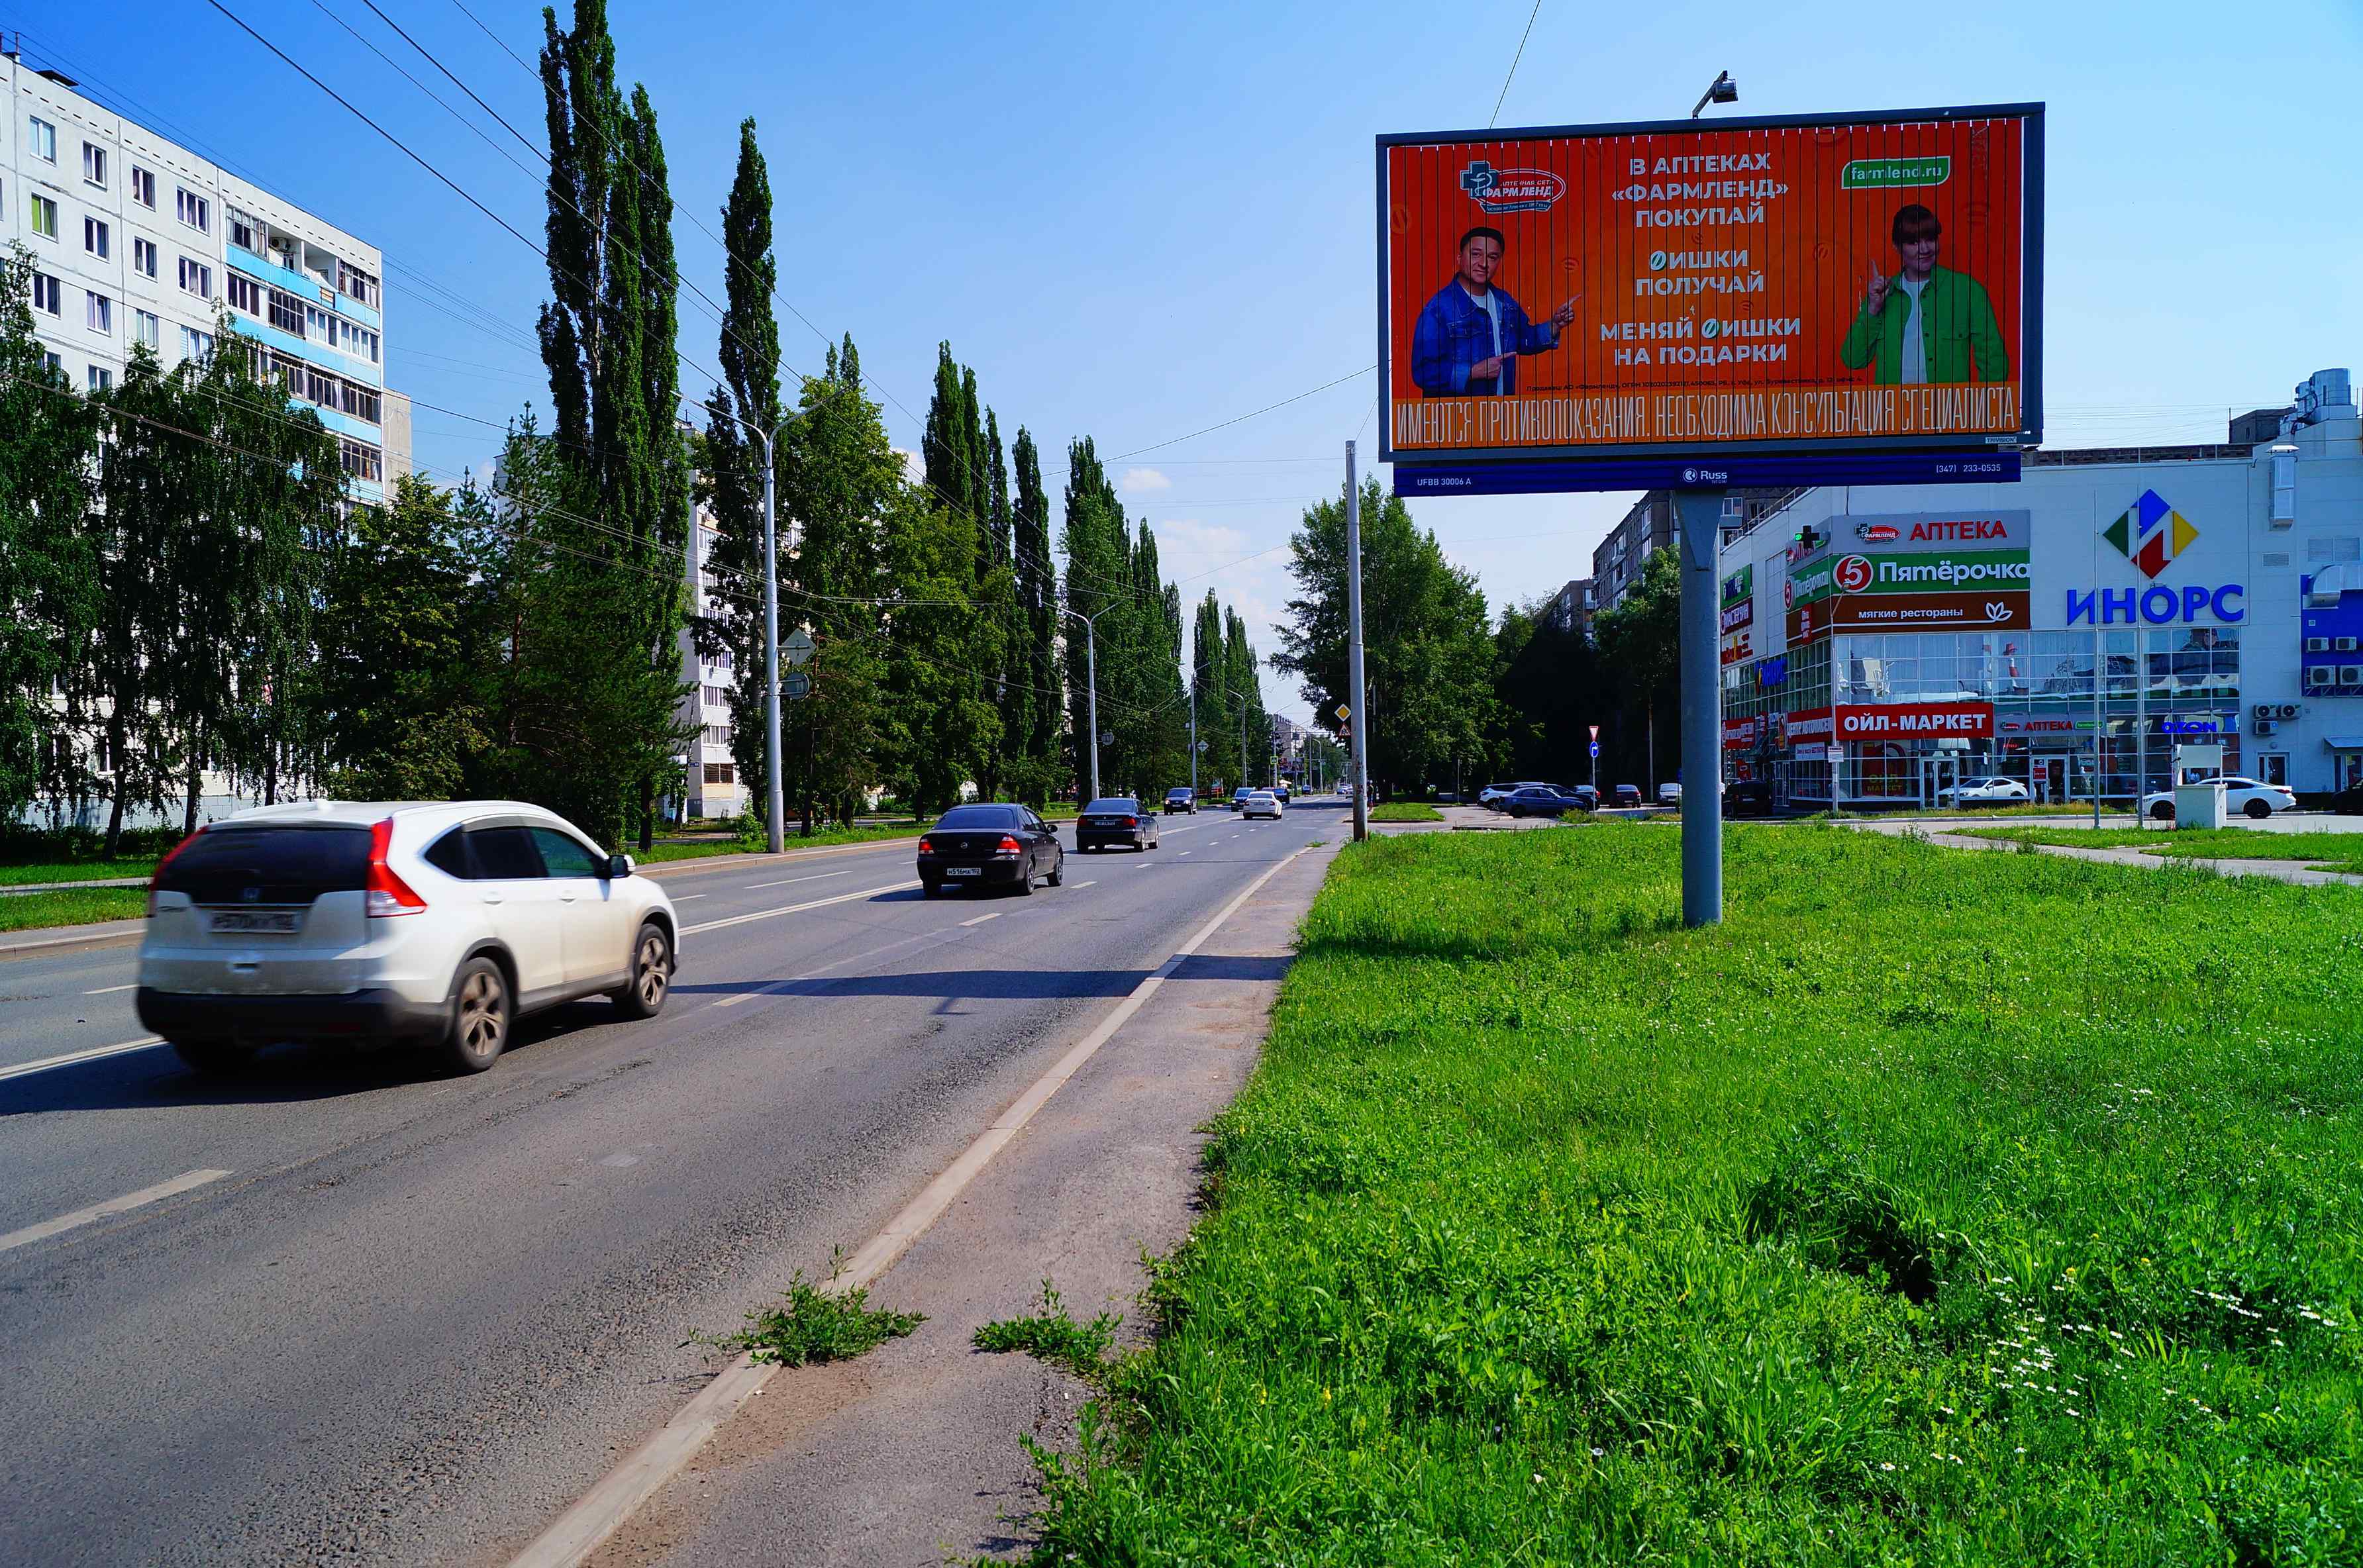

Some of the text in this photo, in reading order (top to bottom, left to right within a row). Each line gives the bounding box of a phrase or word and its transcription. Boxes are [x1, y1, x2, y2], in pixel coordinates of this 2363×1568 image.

[1630, 152, 1771, 175] В АПТЕКАХ
[1851, 166, 1942, 180] farmlend.ru
[1611, 179, 1789, 202] «ФАРМЛЕНД»
[1636, 201, 1764, 228] ПОКУПАЙ
[1636, 270, 1764, 296] ПОЛУЧАЙ
[1600, 317, 1693, 341] МЕНЯЙ
[1615, 344, 1787, 366] НА ПОДАРКИ
[1397, 387, 2015, 444] ИМЕЮТСЯ ПРОТИВОПОКАЗАНИЯ. НЕОБХОДИМА КОНСУЛЬТАЦИЯ СПЕЦИАЛИСТА
[1700, 470, 1728, 480] Russ
[1936, 464, 1956, 473] (347)
[1910, 520, 2007, 541] АПТЕКА
[1880, 560, 2031, 585] Пятёрочка
[1858, 609, 1963, 619] мягкие рестораны
[2066, 584, 2244, 626] ИНОРС
[1844, 712, 1986, 732] ОЙЛ-МАРКЕТ
[2024, 720, 2074, 732] АПТЕКА
[2162, 721, 2217, 734] OZON
